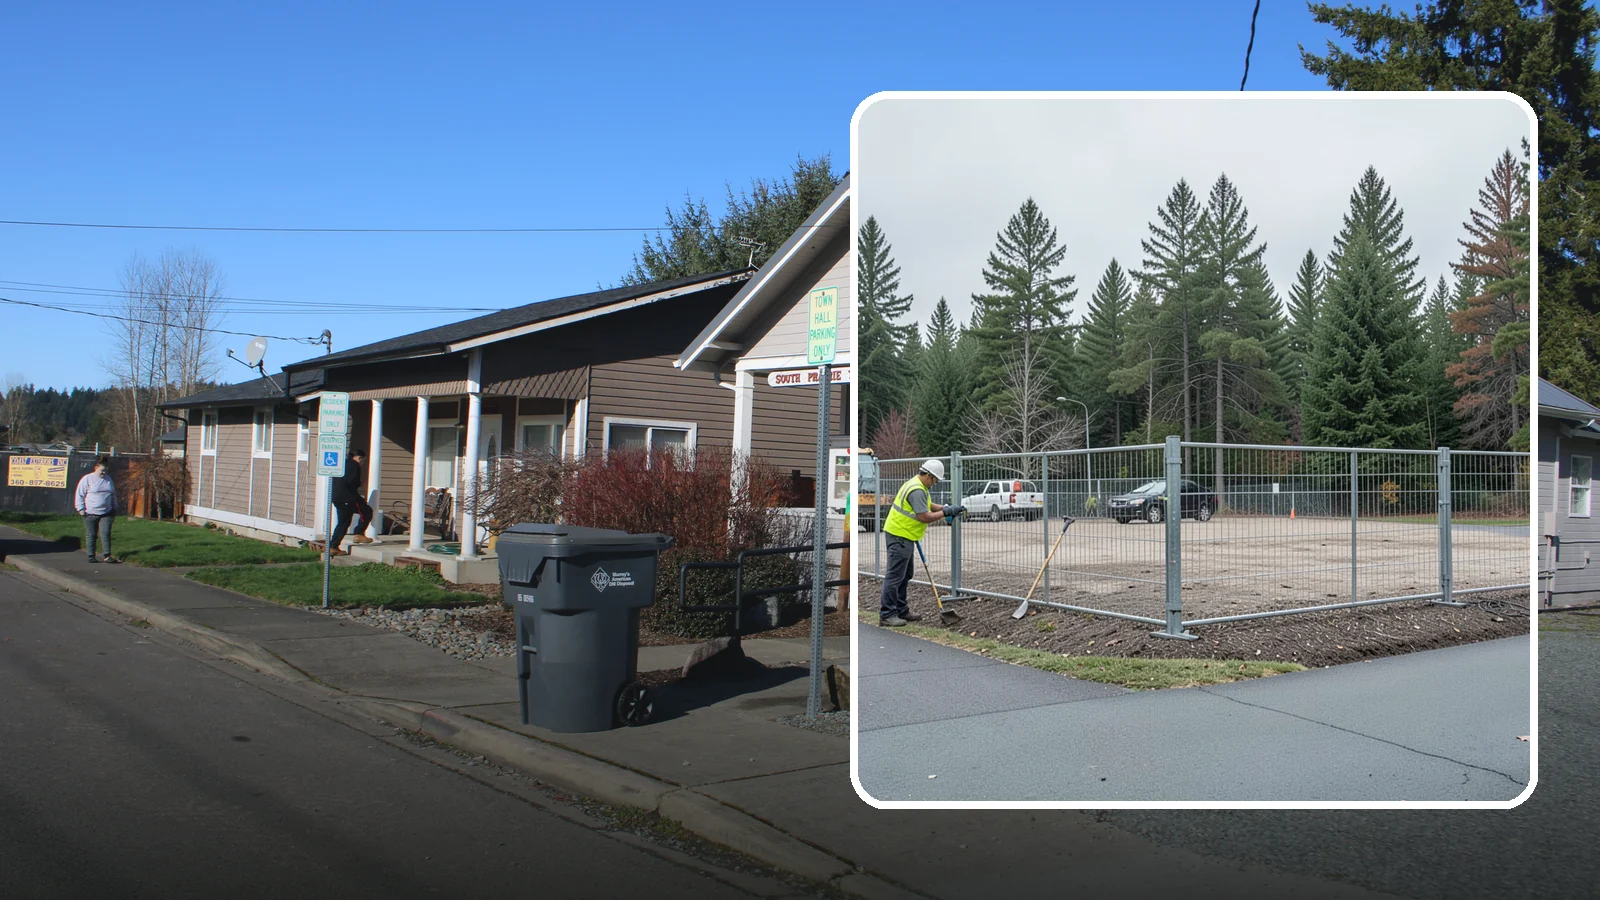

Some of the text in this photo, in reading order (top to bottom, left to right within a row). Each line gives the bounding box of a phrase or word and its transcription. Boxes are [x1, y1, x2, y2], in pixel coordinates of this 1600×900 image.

[815, 295, 832, 308] TOWN
[814, 311, 831, 324] HALL
[810, 326, 836, 340] PARKING
[814, 344, 830, 357] ONLY
[776, 374, 801, 384] SOUTH
